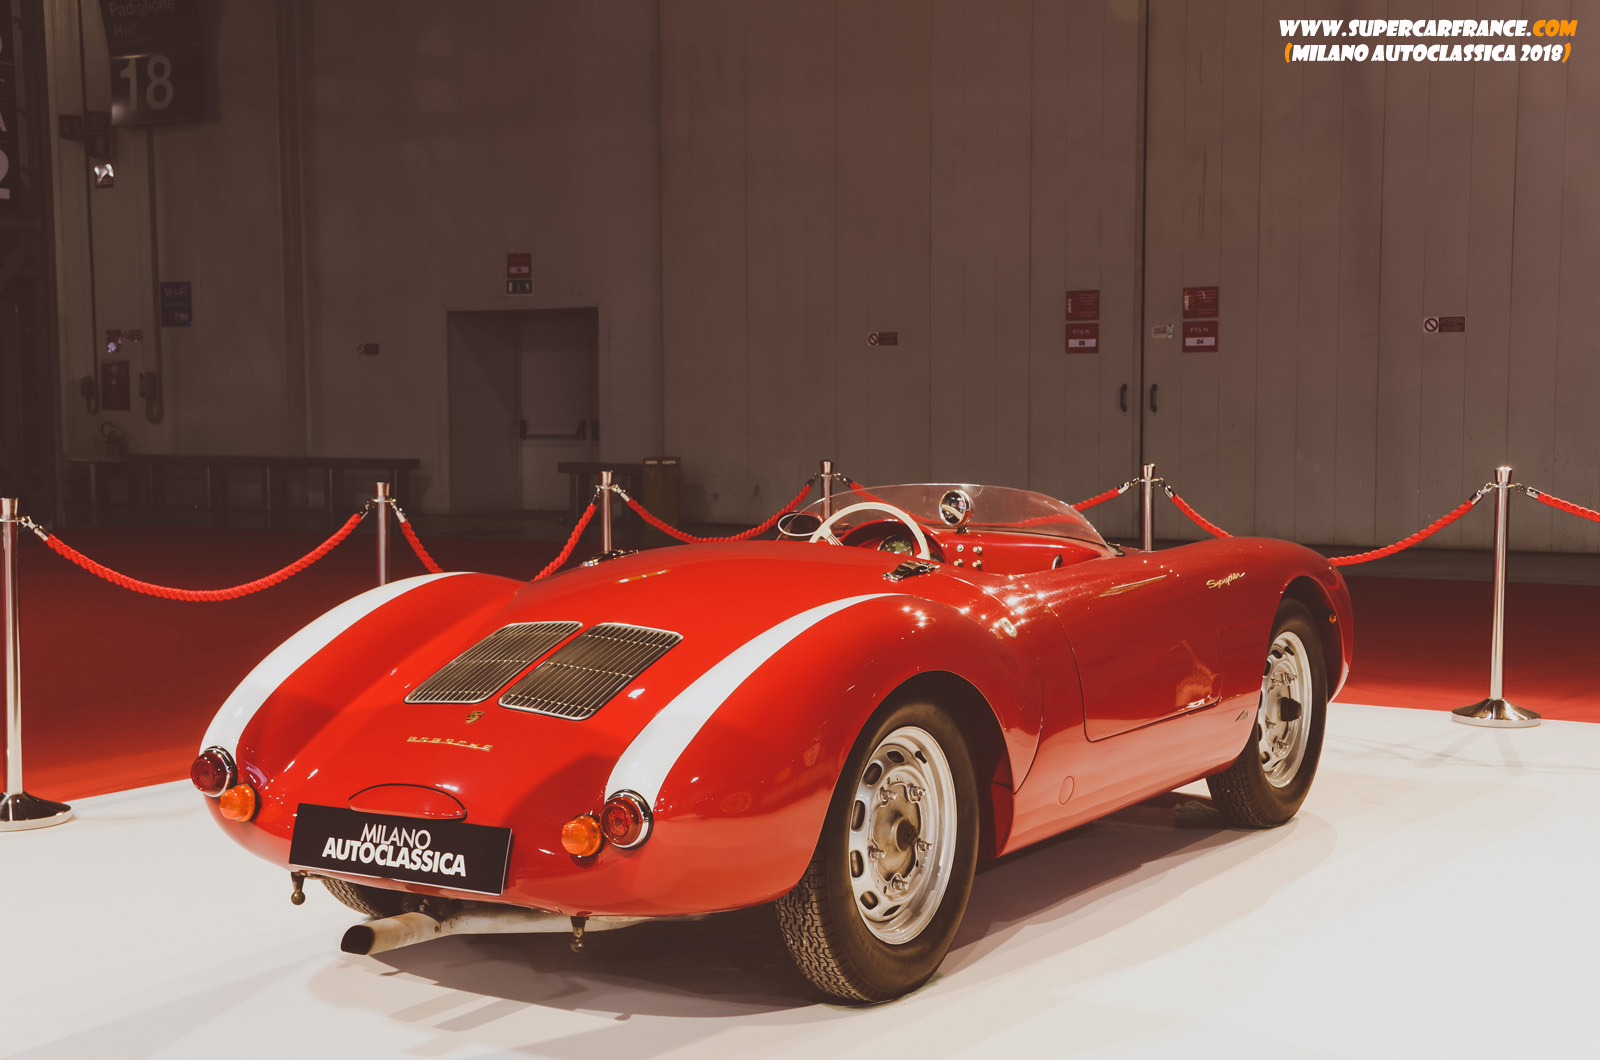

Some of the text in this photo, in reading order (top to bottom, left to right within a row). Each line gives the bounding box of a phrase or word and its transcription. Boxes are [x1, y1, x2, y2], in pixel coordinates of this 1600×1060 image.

[109, 0, 175, 18] Padiglione
[113, 23, 137, 38] Hall
[120, 54, 174, 112] 18
[360, 823, 431, 850] MILANO
[321, 837, 467, 877] AUTOCLASSICA
